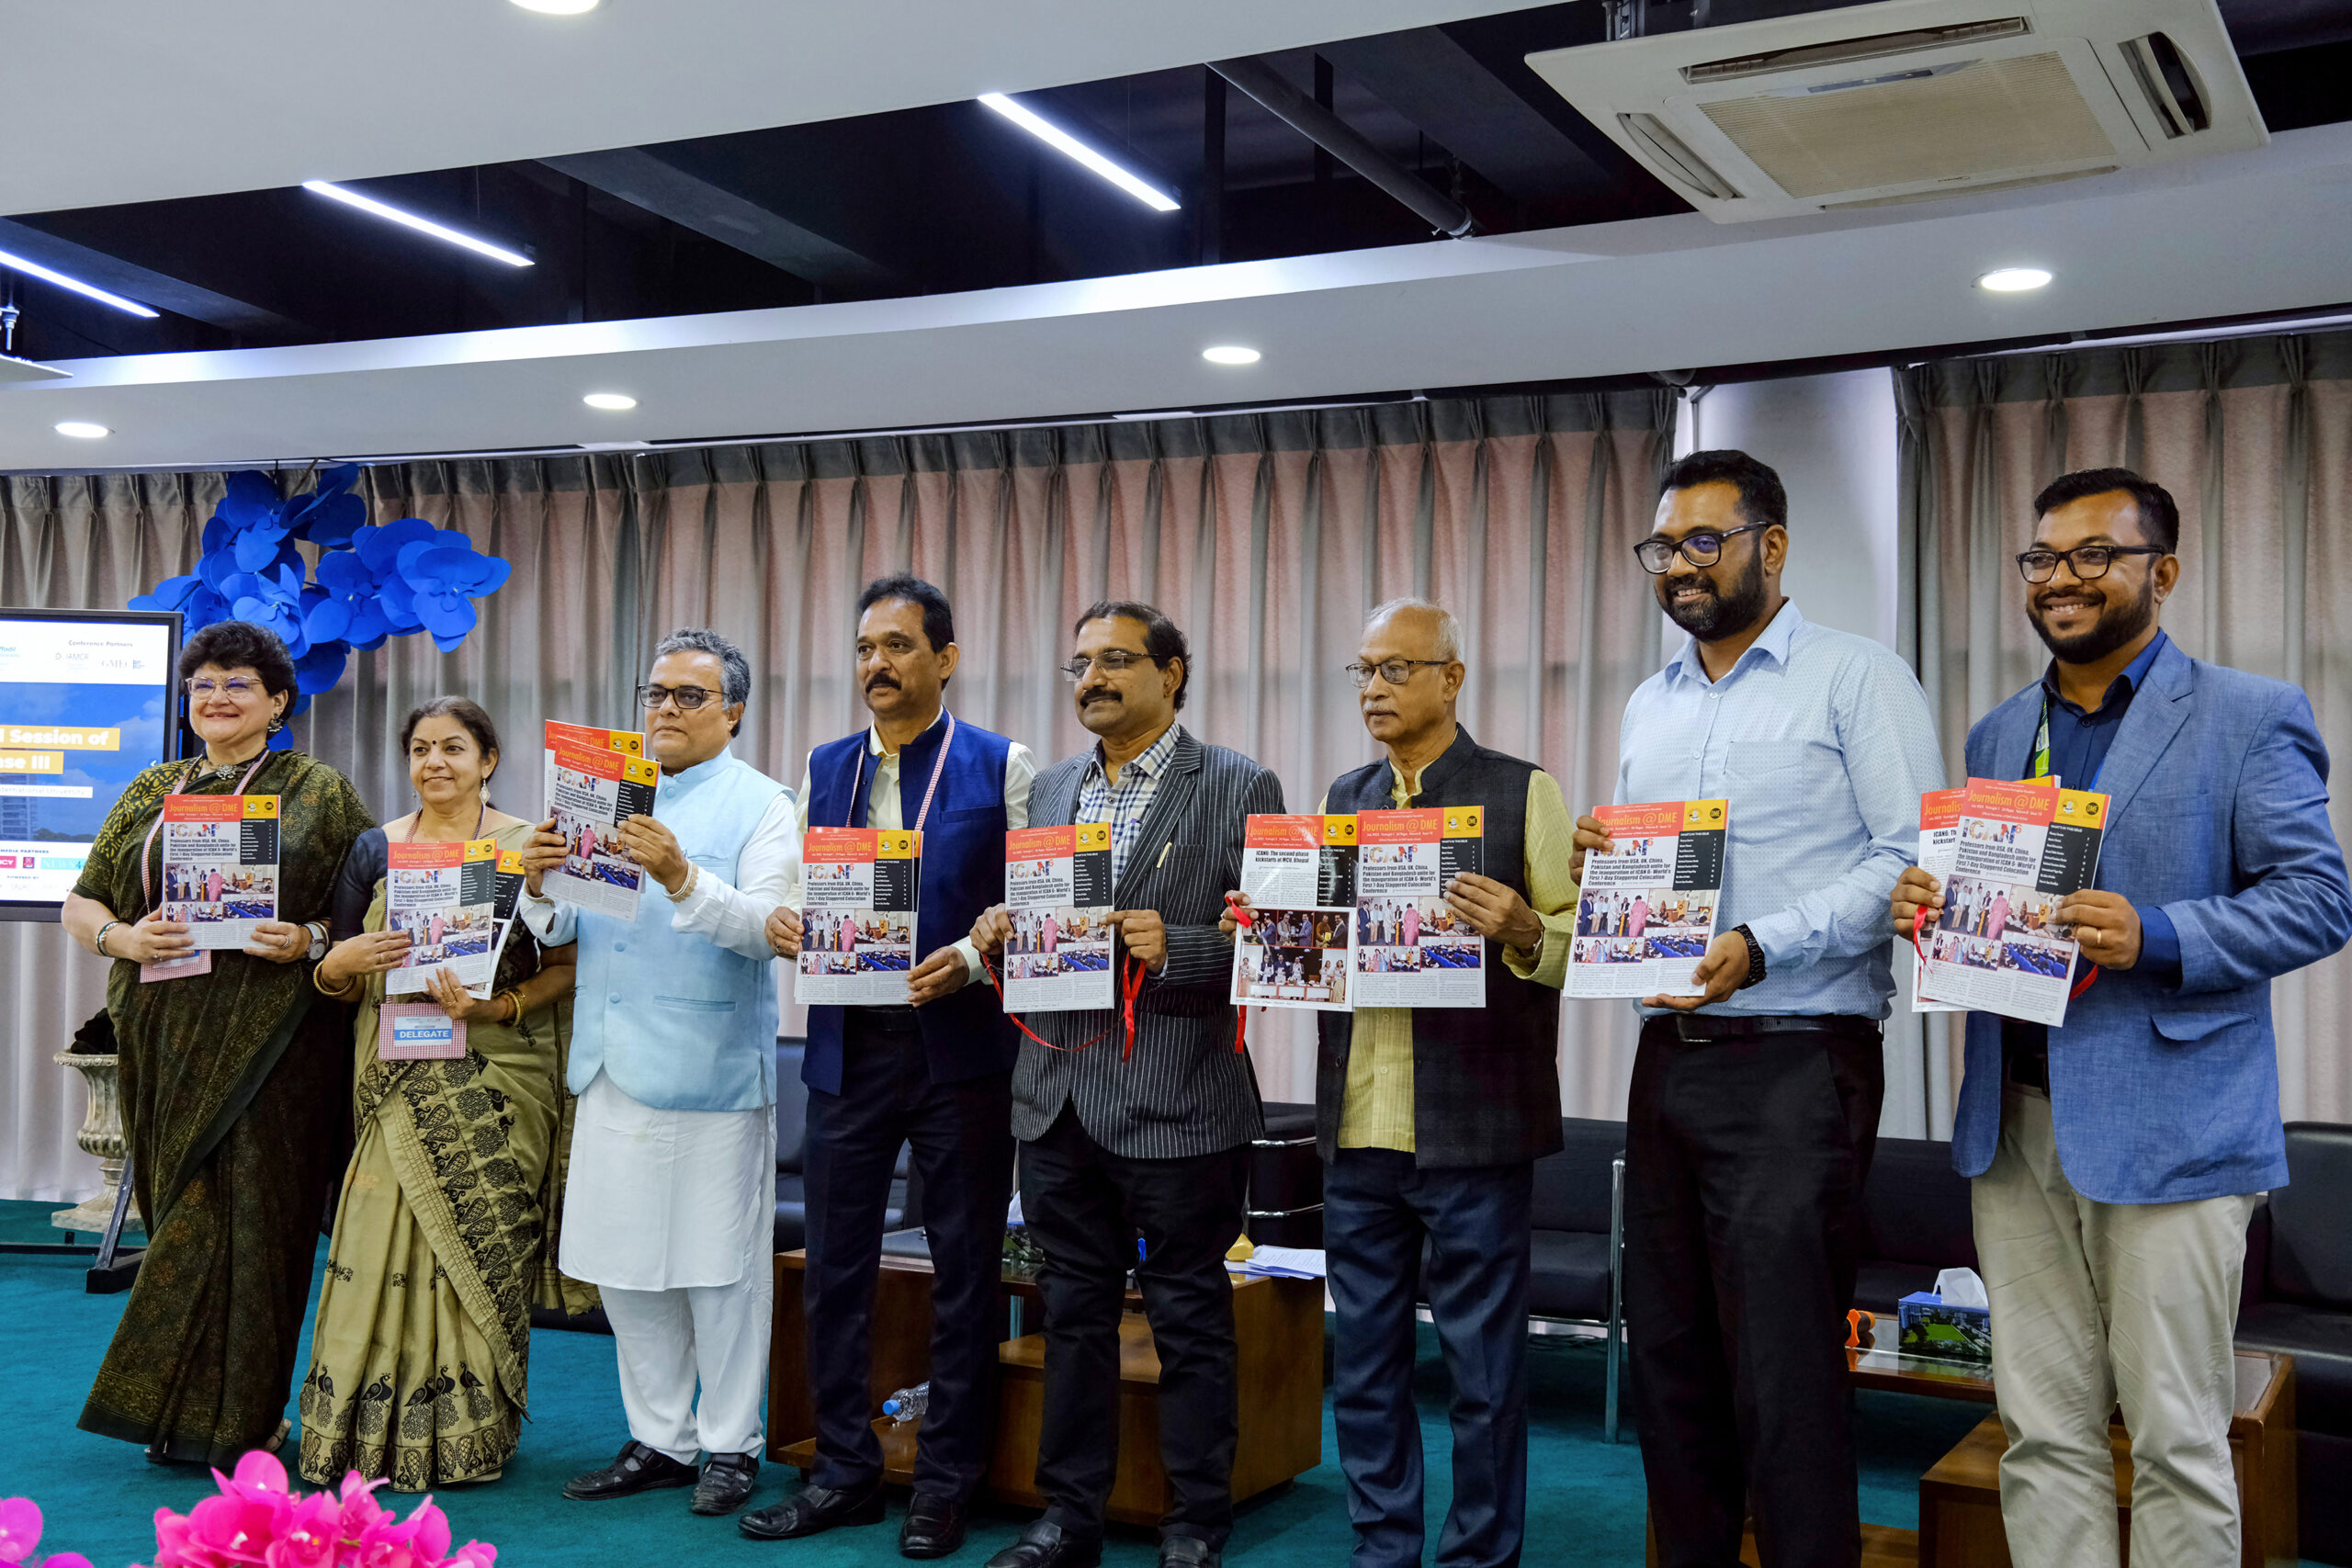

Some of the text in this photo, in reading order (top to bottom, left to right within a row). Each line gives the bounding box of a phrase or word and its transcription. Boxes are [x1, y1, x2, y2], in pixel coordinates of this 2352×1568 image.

[10, 728, 83, 745] Session
[88, 730, 110, 745] of
[31, 755, 50, 770] III
[1967, 789, 2013, 806] Journalism
[2029, 797, 2051, 811] DME
[170, 803, 207, 812] Journalism
[1925, 801, 1962, 816] Journalis
[1362, 820, 1404, 832] Journalism
[1420, 819, 1438, 830] DME
[1658, 813, 1677, 824] DME
[1250, 825, 1286, 837] Journalism
[808, 842, 843, 852] Journalism
[857, 842, 872, 851] DME
[1009, 837, 1042, 850] Journalism
[1056, 835, 1070, 846] DME
